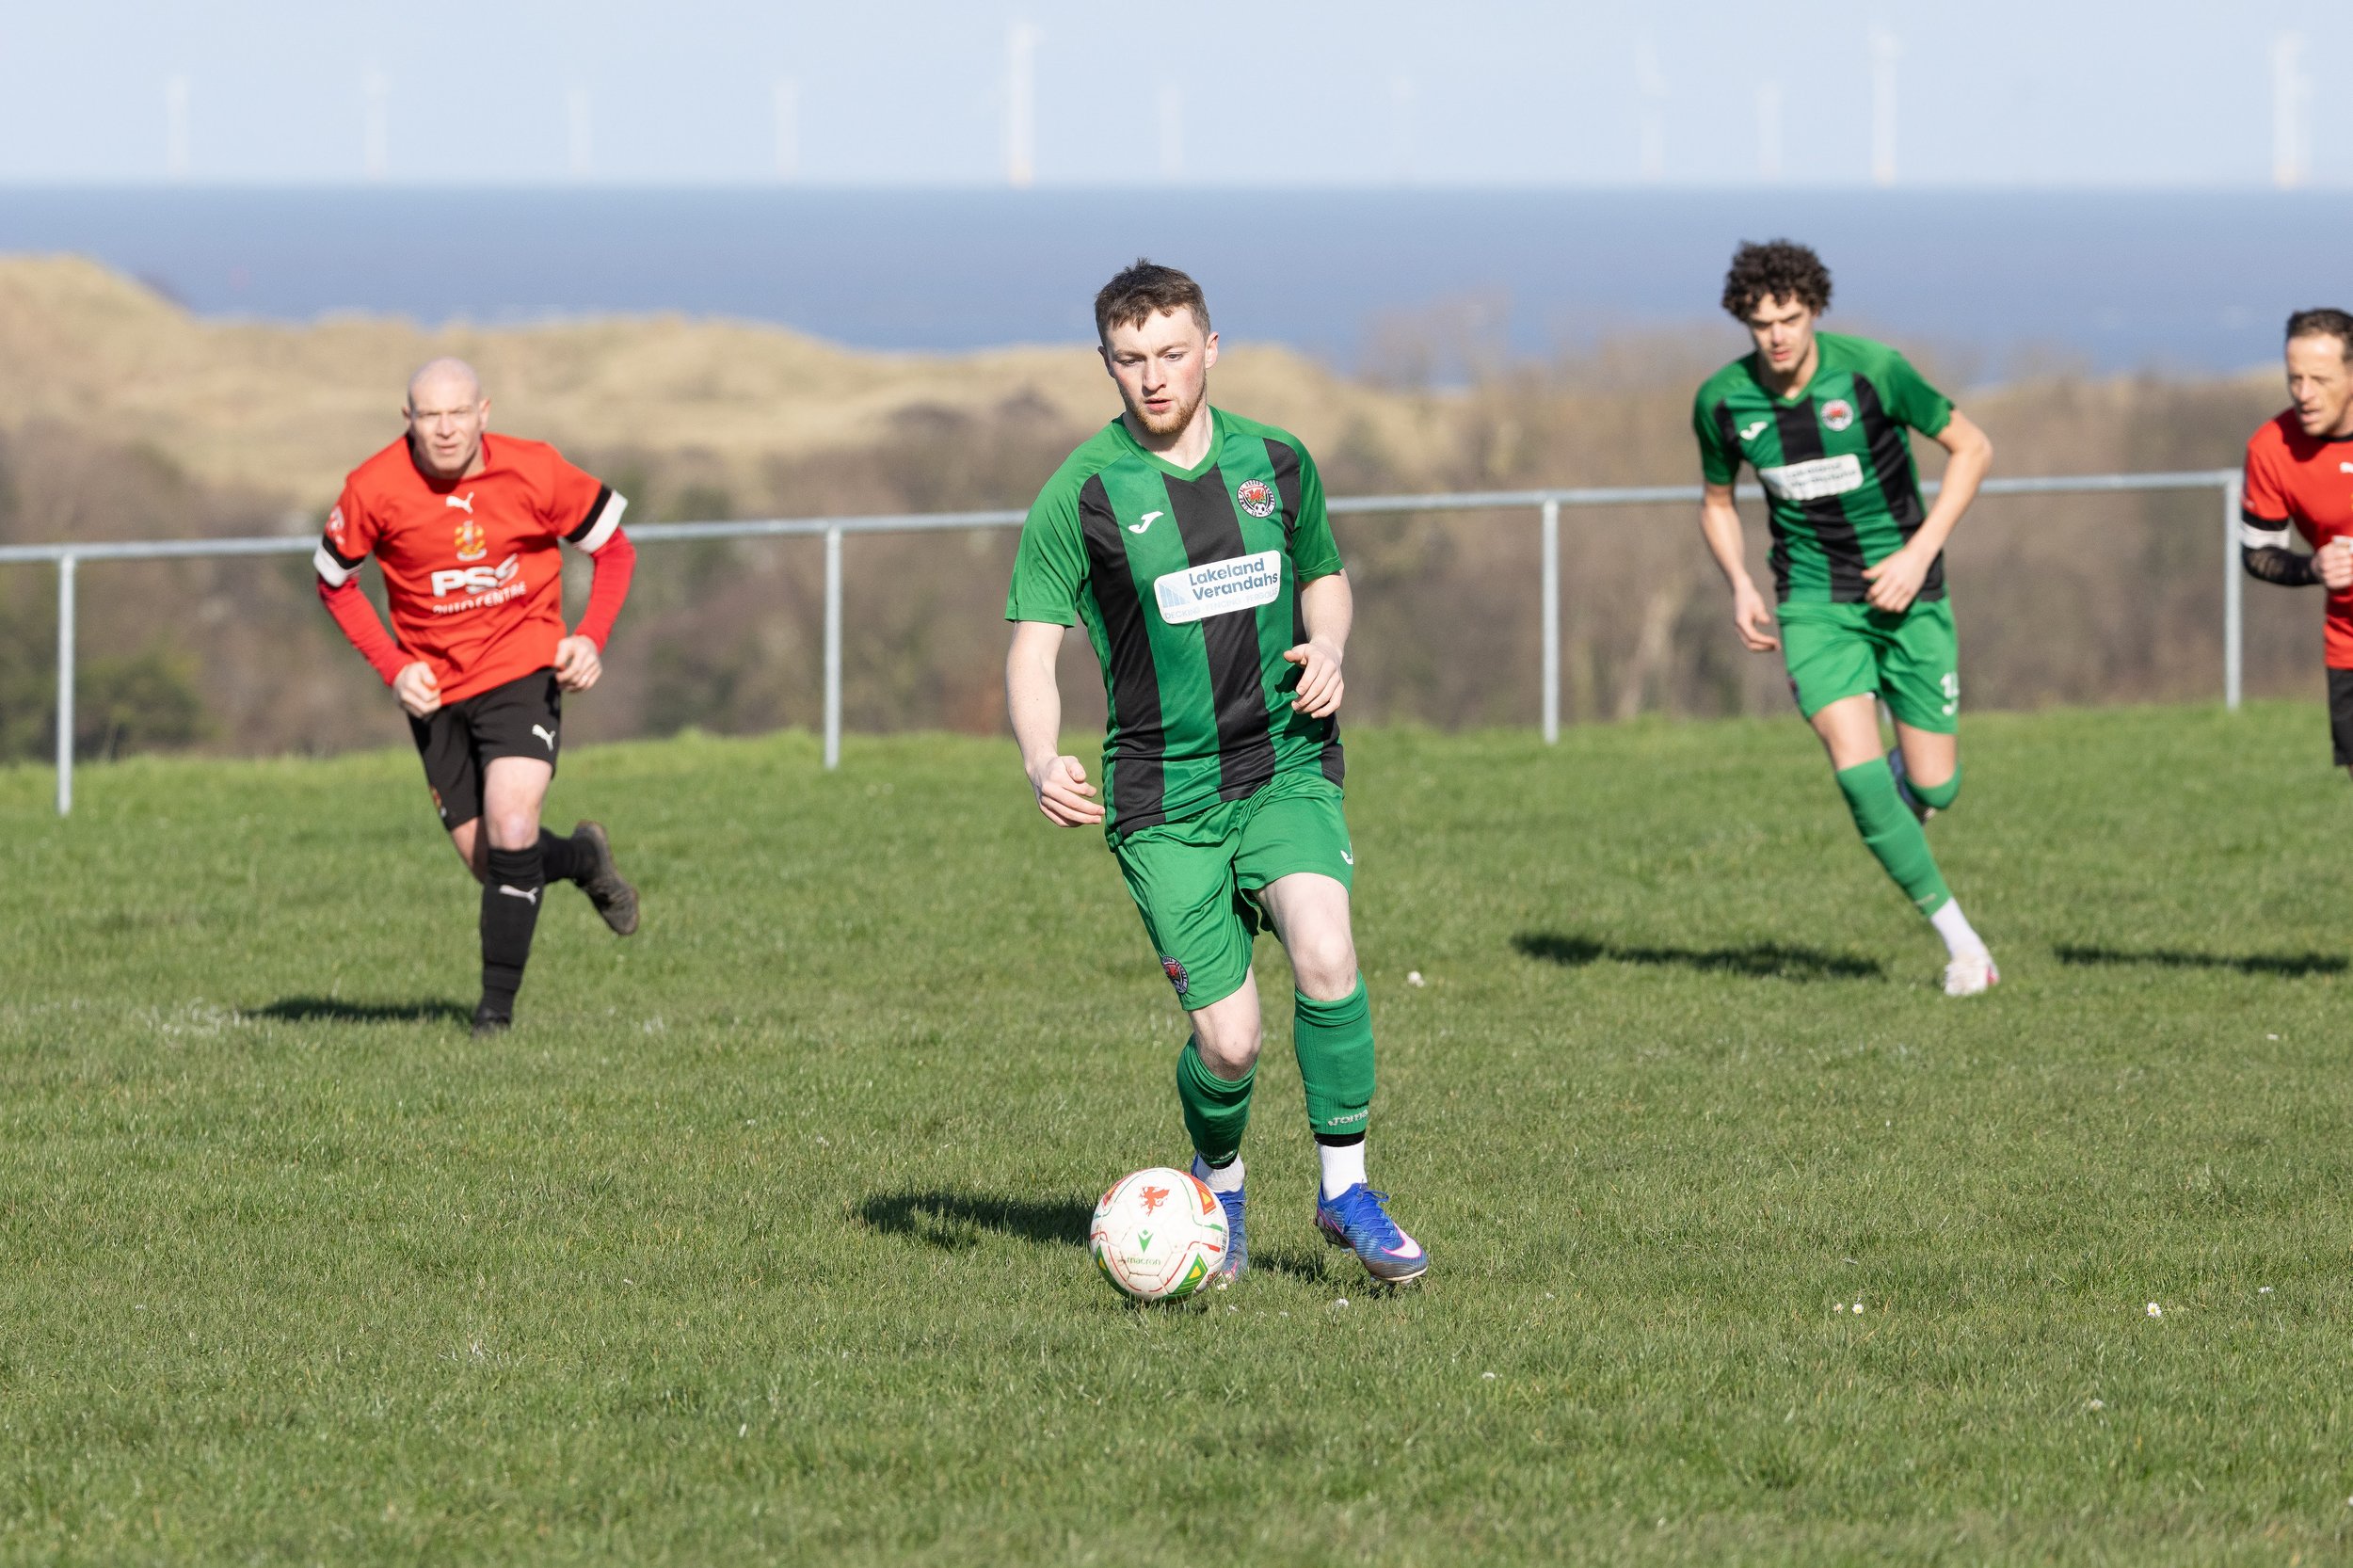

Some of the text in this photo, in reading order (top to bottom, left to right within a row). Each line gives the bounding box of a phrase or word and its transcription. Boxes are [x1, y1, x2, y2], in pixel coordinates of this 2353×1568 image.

[1189, 557, 1265, 586] Lakeland
[1192, 572, 1278, 600] Verandahs
[1127, 1256, 1161, 1266] macron
